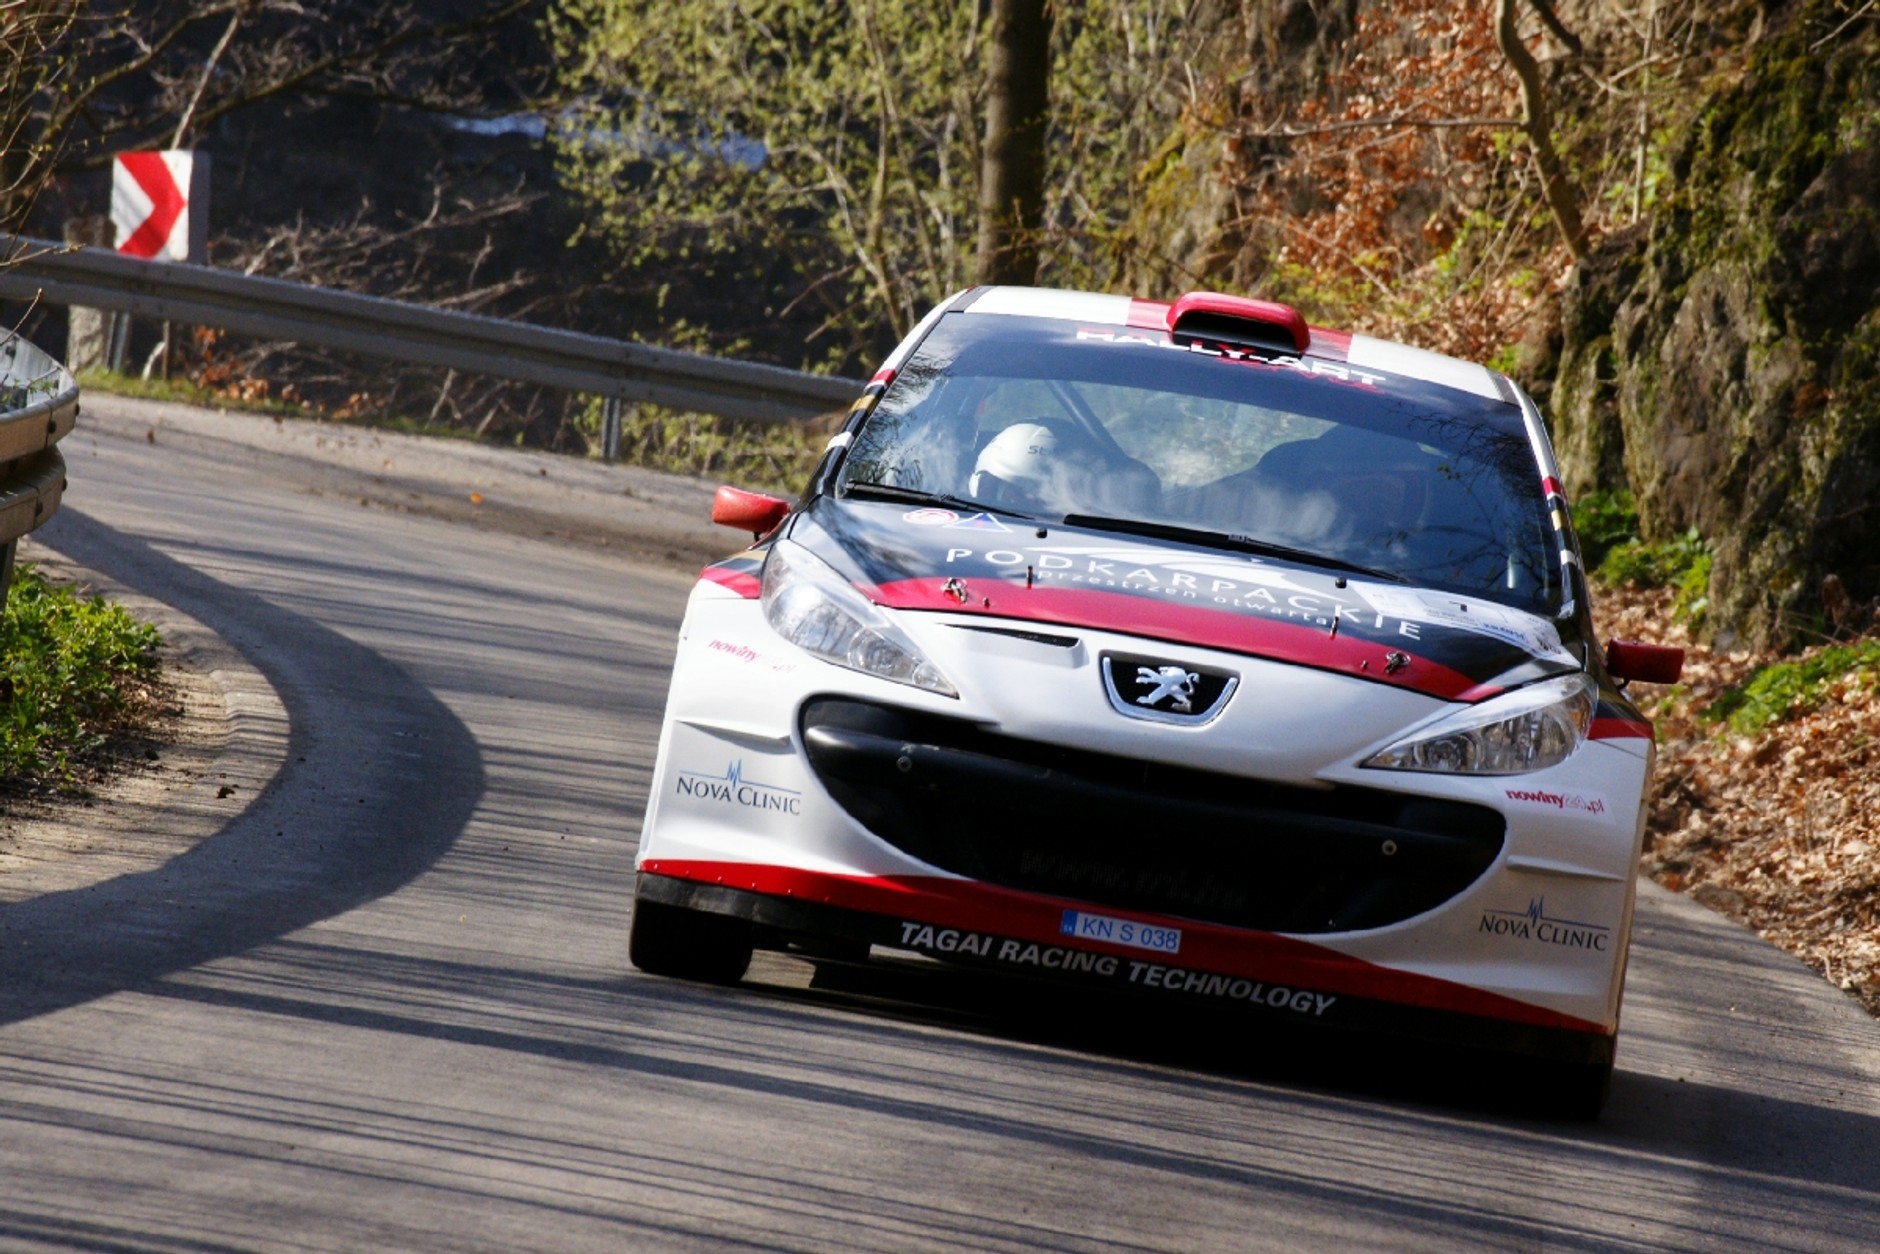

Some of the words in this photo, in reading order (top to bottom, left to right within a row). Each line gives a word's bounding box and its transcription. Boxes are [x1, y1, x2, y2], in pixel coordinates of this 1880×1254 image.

[946, 548, 1421, 640] PODKARPACKIE
[1213, 596, 1327, 625] otwarta
[677, 777, 731, 802] NOVA
[738, 786, 801, 816] CLINIC
[1082, 917, 1114, 939] KN
[1119, 923, 1134, 942] S
[1140, 928, 1178, 950] 038
[1478, 914, 1530, 939] NOVA
[1536, 922, 1608, 951] CLINIC
[901, 921, 992, 956] TAGAI
[998, 940, 1119, 976] RACING
[1128, 961, 1337, 1016] TECHNOLOGY
